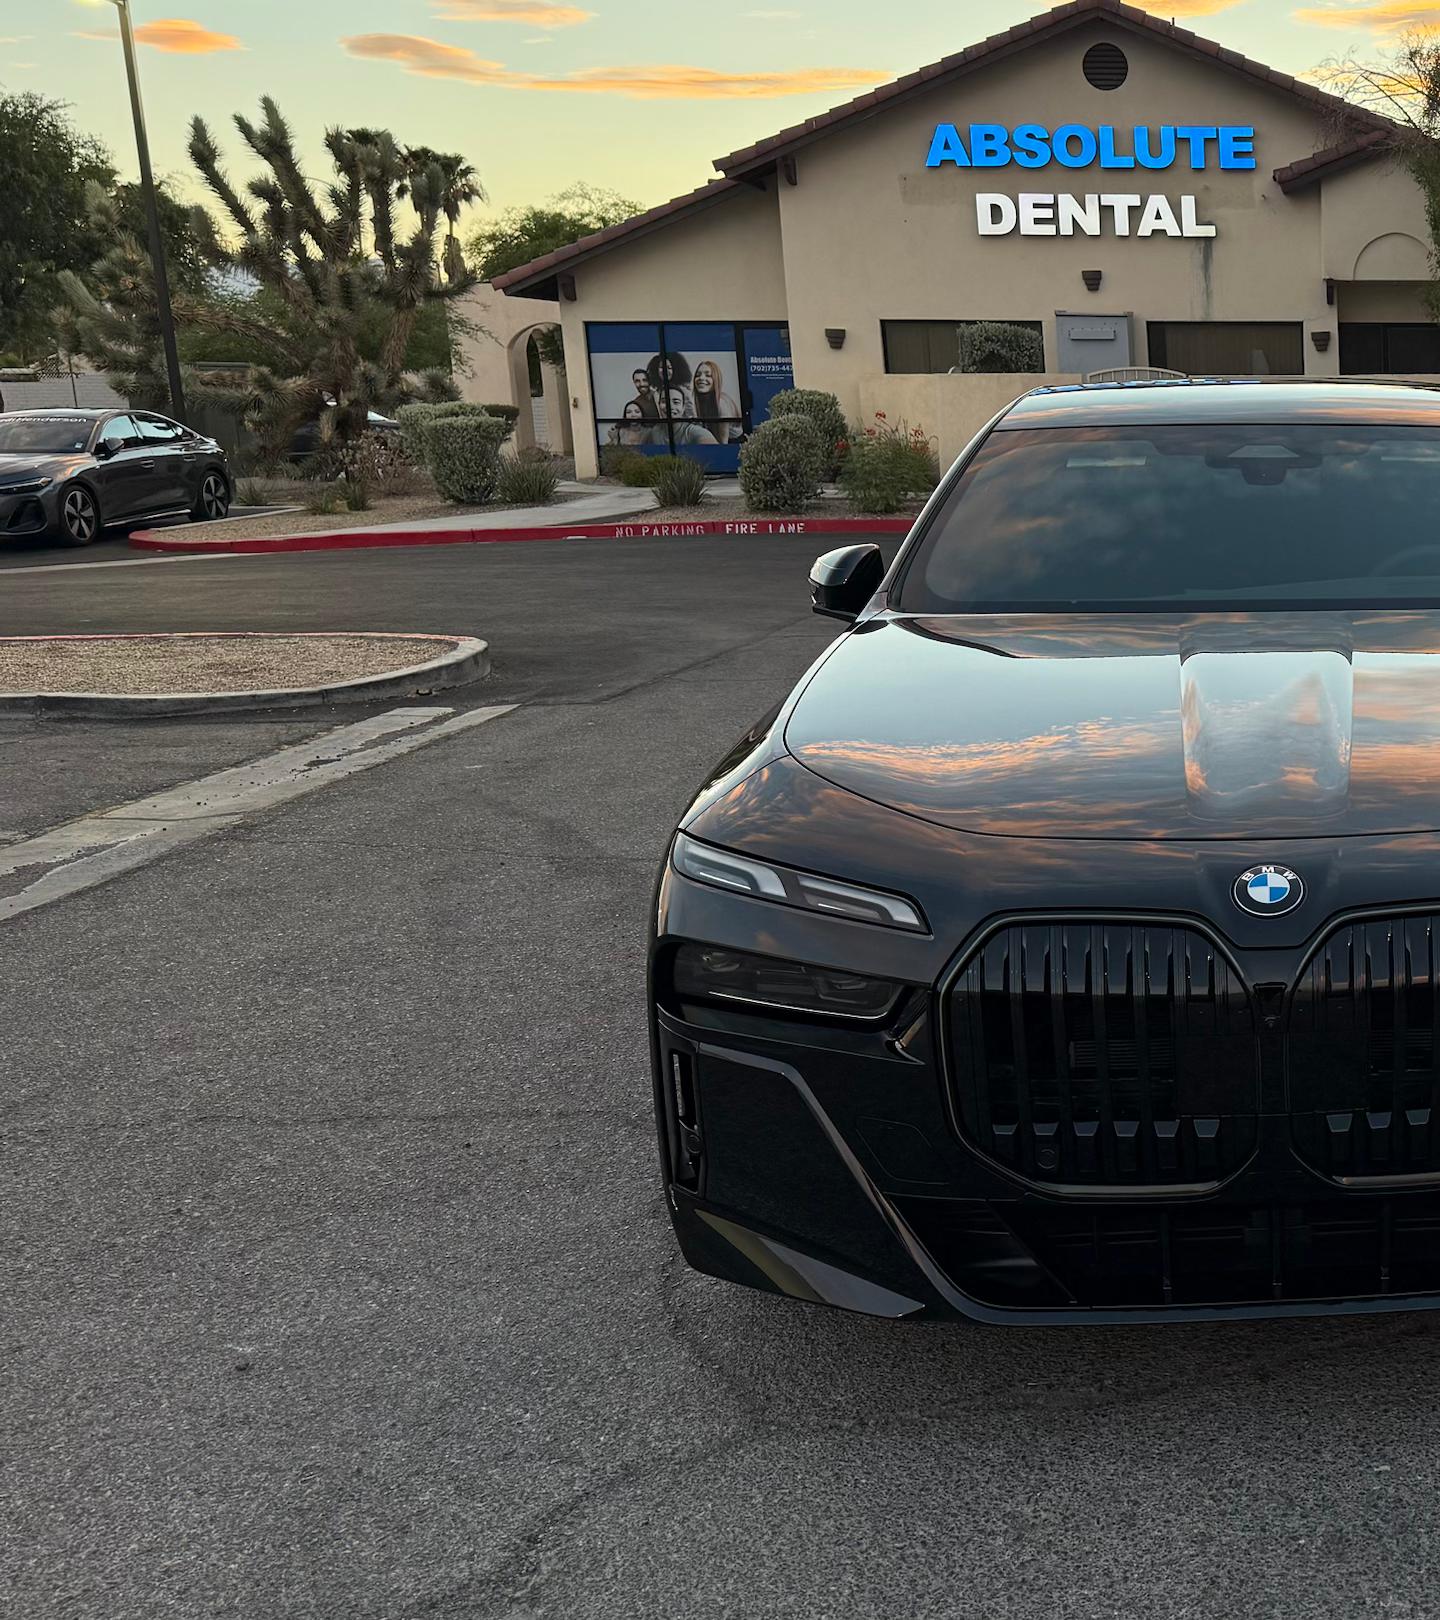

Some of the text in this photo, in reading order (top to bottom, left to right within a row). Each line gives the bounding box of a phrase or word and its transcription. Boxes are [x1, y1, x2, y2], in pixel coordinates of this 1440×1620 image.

[925, 124, 1256, 169] ABSOLUTE
[975, 192, 1217, 237] DENTAL
[615, 526, 634, 538] NO
[642, 525, 704, 536] PARKING
[725, 523, 757, 534] FIRE
[1241, 866, 1296, 881] BMW
